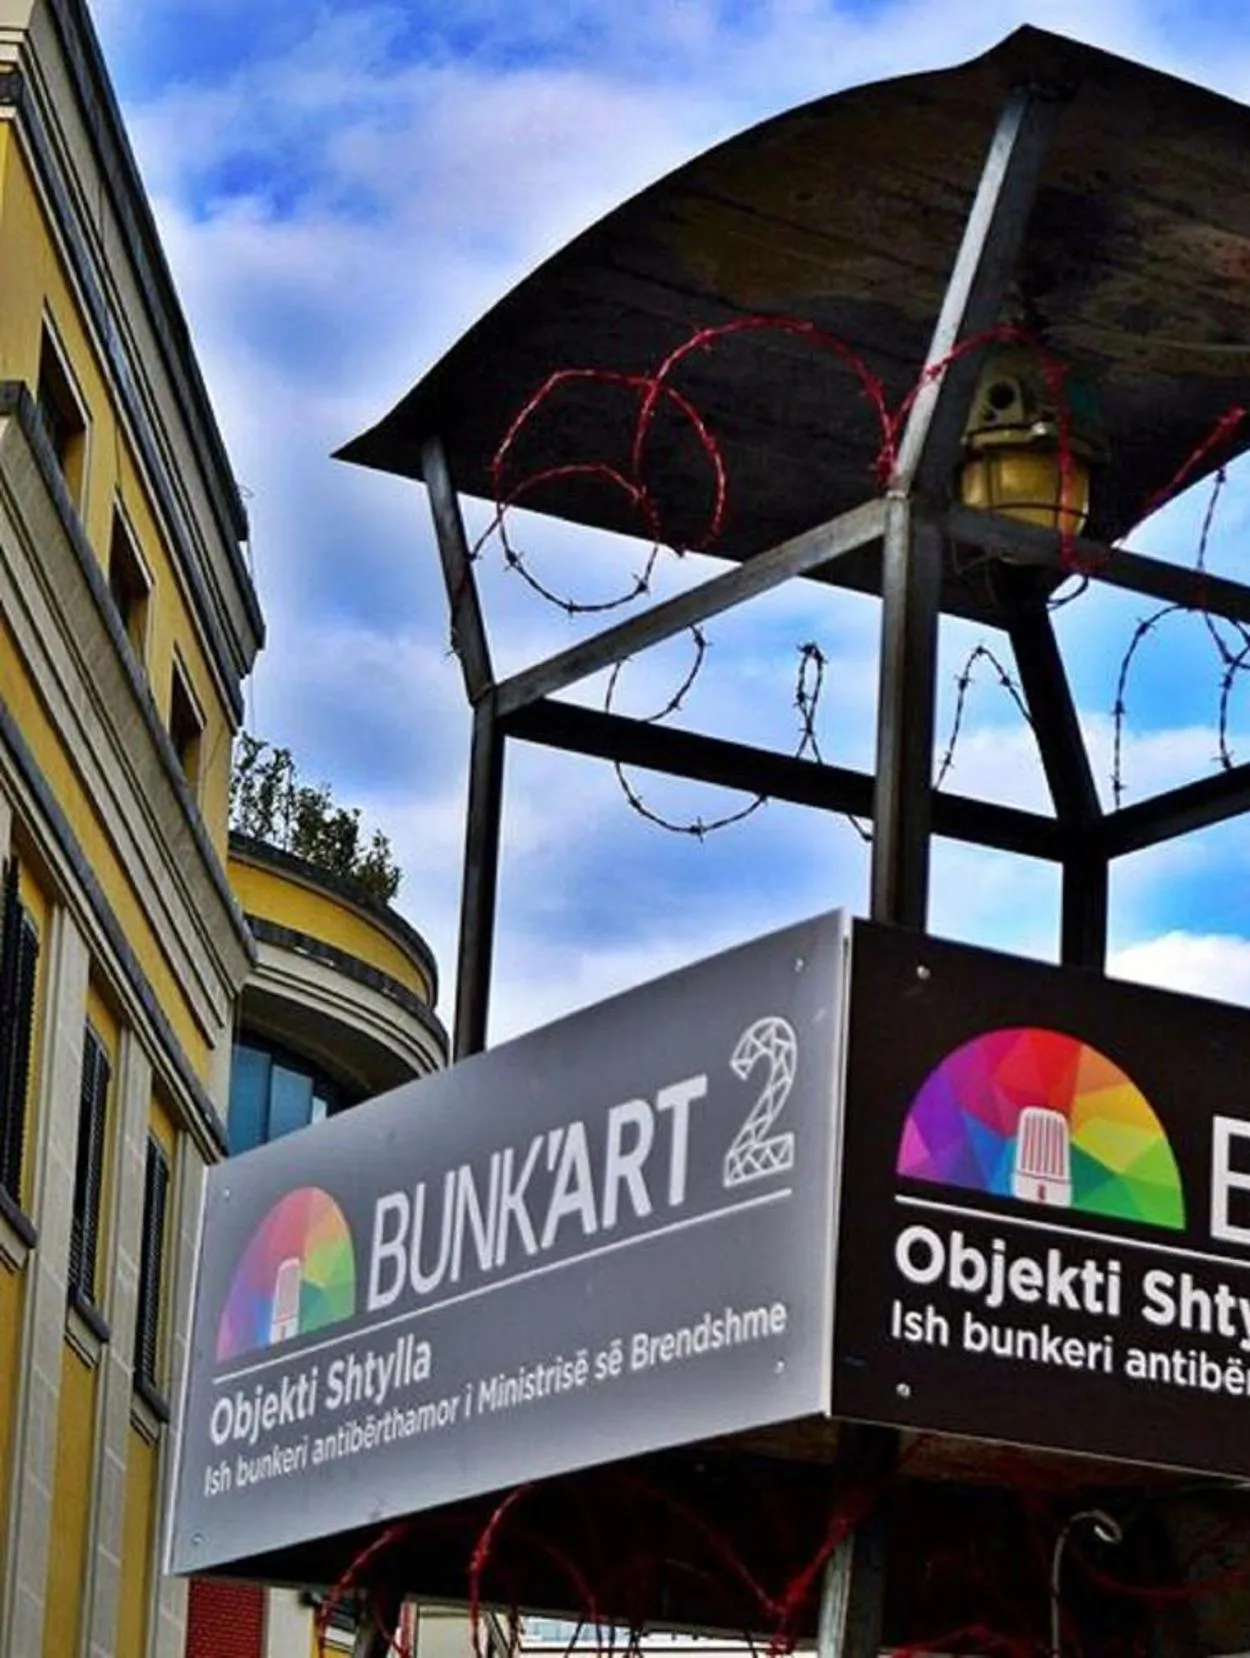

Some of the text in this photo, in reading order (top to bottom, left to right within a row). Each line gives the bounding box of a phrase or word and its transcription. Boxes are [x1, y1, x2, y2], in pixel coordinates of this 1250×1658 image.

[367, 1016, 798, 1313] BUNK'ART 2
[894, 1225, 1122, 1317] Objekti
[210, 1333, 432, 1446] Objekti Shtylla
[891, 1301, 949, 1346] Ish
[962, 1311, 1113, 1373] bunkeri
[204, 1302, 788, 1498] Ish bunkeri antibërthamor i Ministrisë së Brendshme
